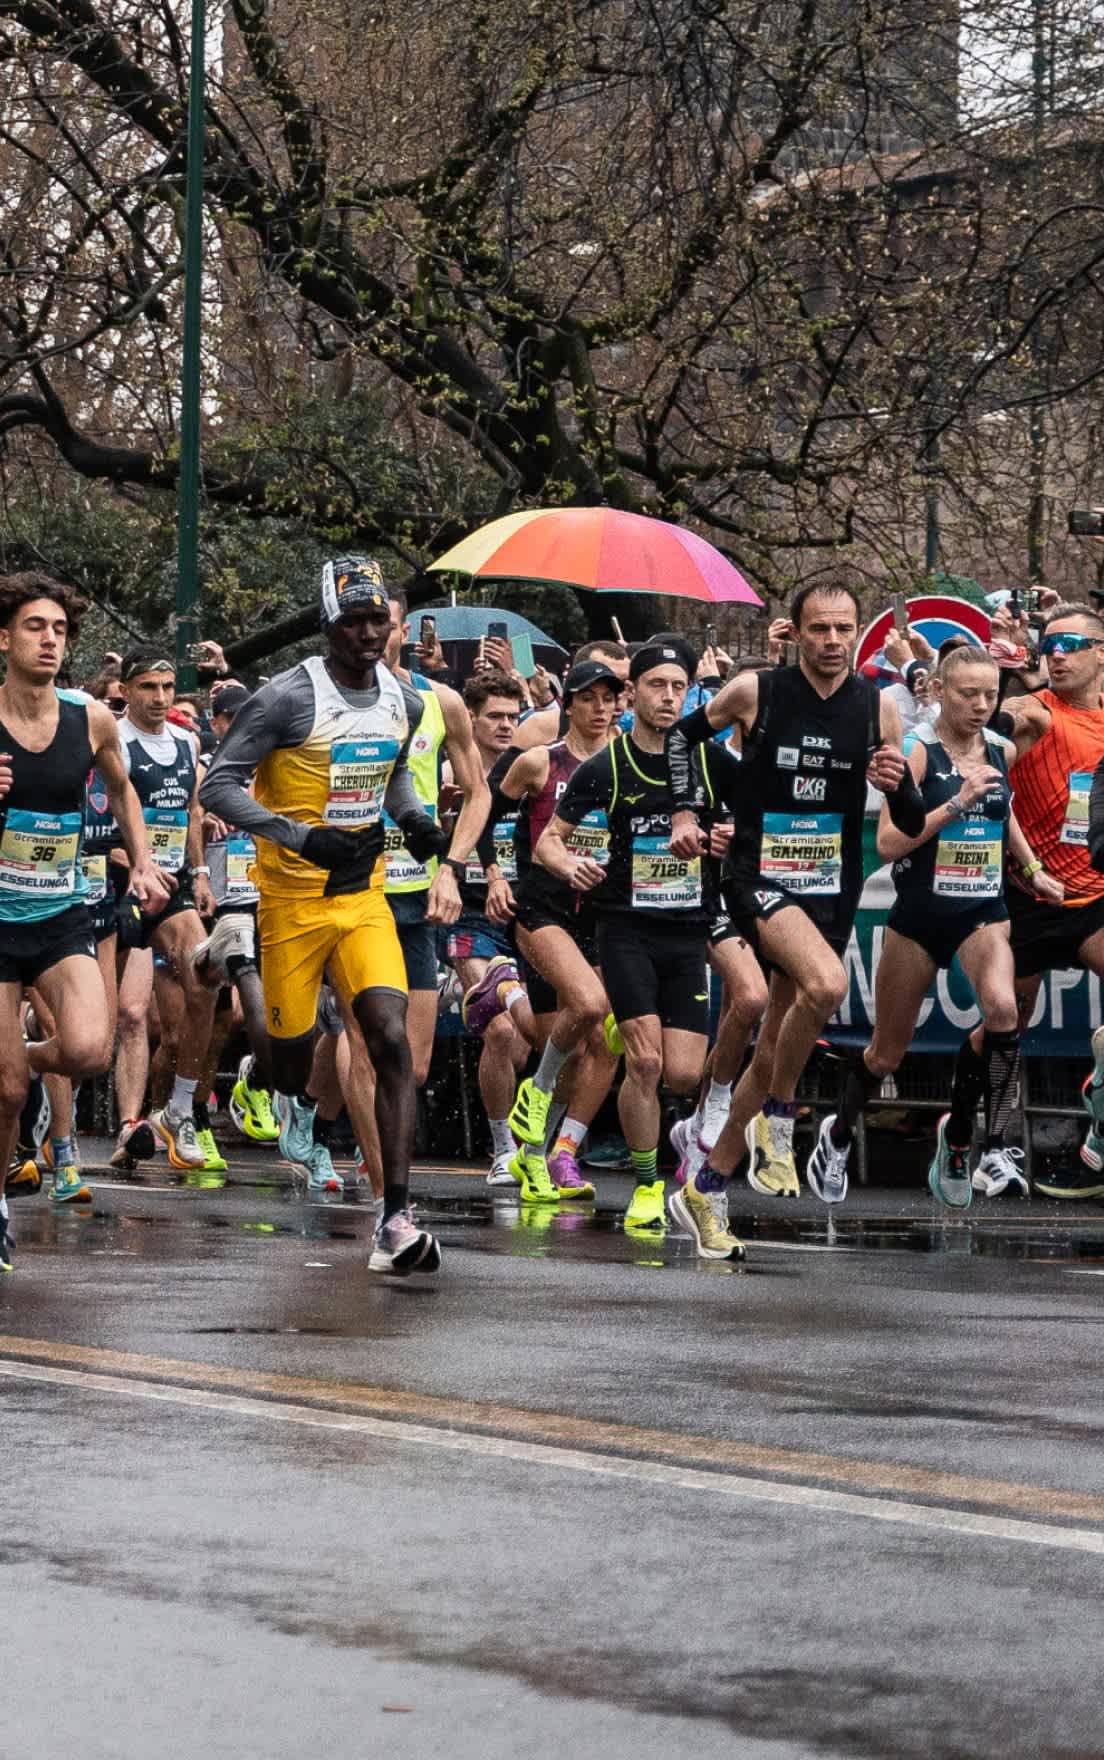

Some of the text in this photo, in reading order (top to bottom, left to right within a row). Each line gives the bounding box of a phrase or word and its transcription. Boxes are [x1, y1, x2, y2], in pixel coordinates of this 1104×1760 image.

[152, 834, 169, 847] 32
[30, 847, 56, 862] 36
[771, 846, 836, 860] GAMBINO
[954, 851, 991, 865] REINA
[650, 862, 689, 878] 7126
[0, 872, 70, 889] ESSELUNGA
[938, 881, 1001, 892] ESSELUNGA
[635, 892, 699, 903] ESSELUNGA
